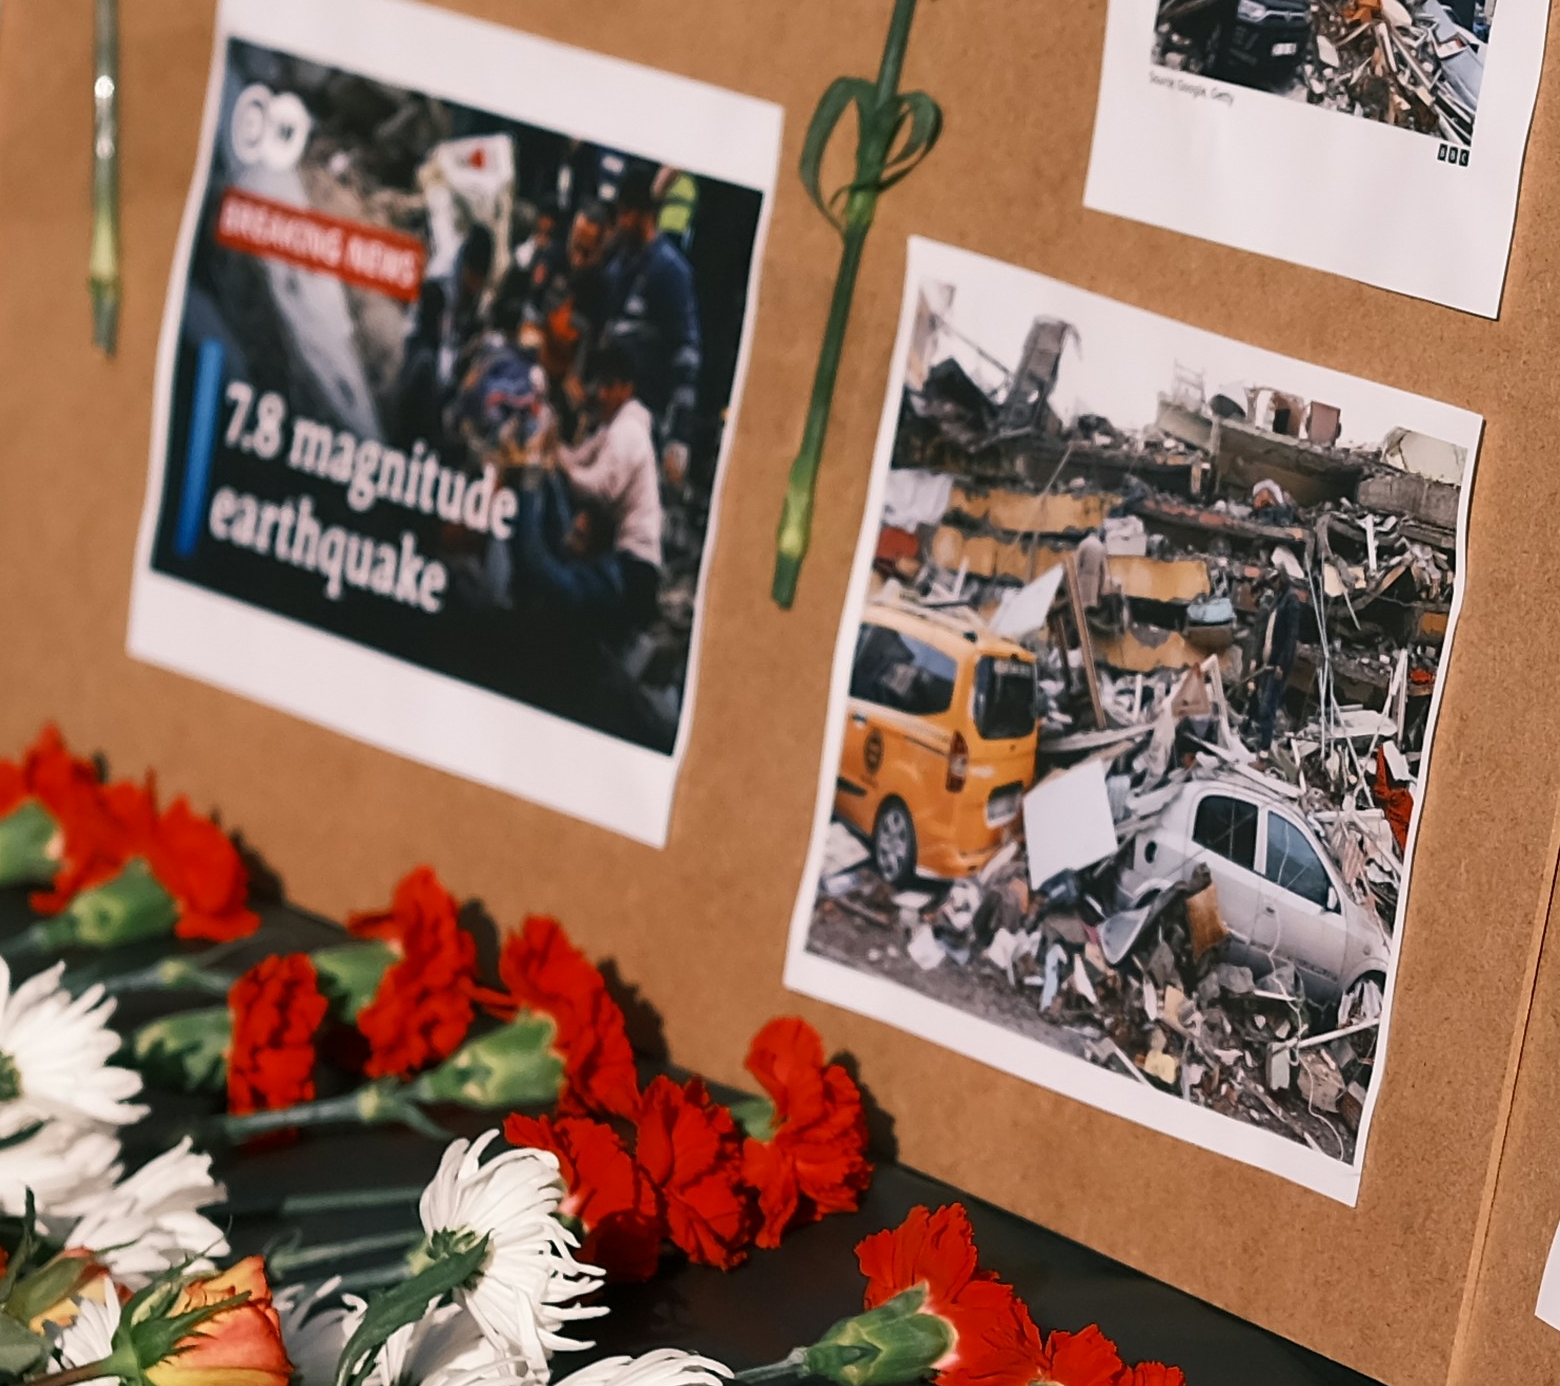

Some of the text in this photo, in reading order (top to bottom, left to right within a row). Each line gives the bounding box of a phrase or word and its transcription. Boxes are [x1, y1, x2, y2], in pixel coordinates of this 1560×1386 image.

[1437, 143, 1471, 167] BBC
[225, 379, 519, 542] 7.8 magnitude
[208, 484, 448, 614] earthquake
